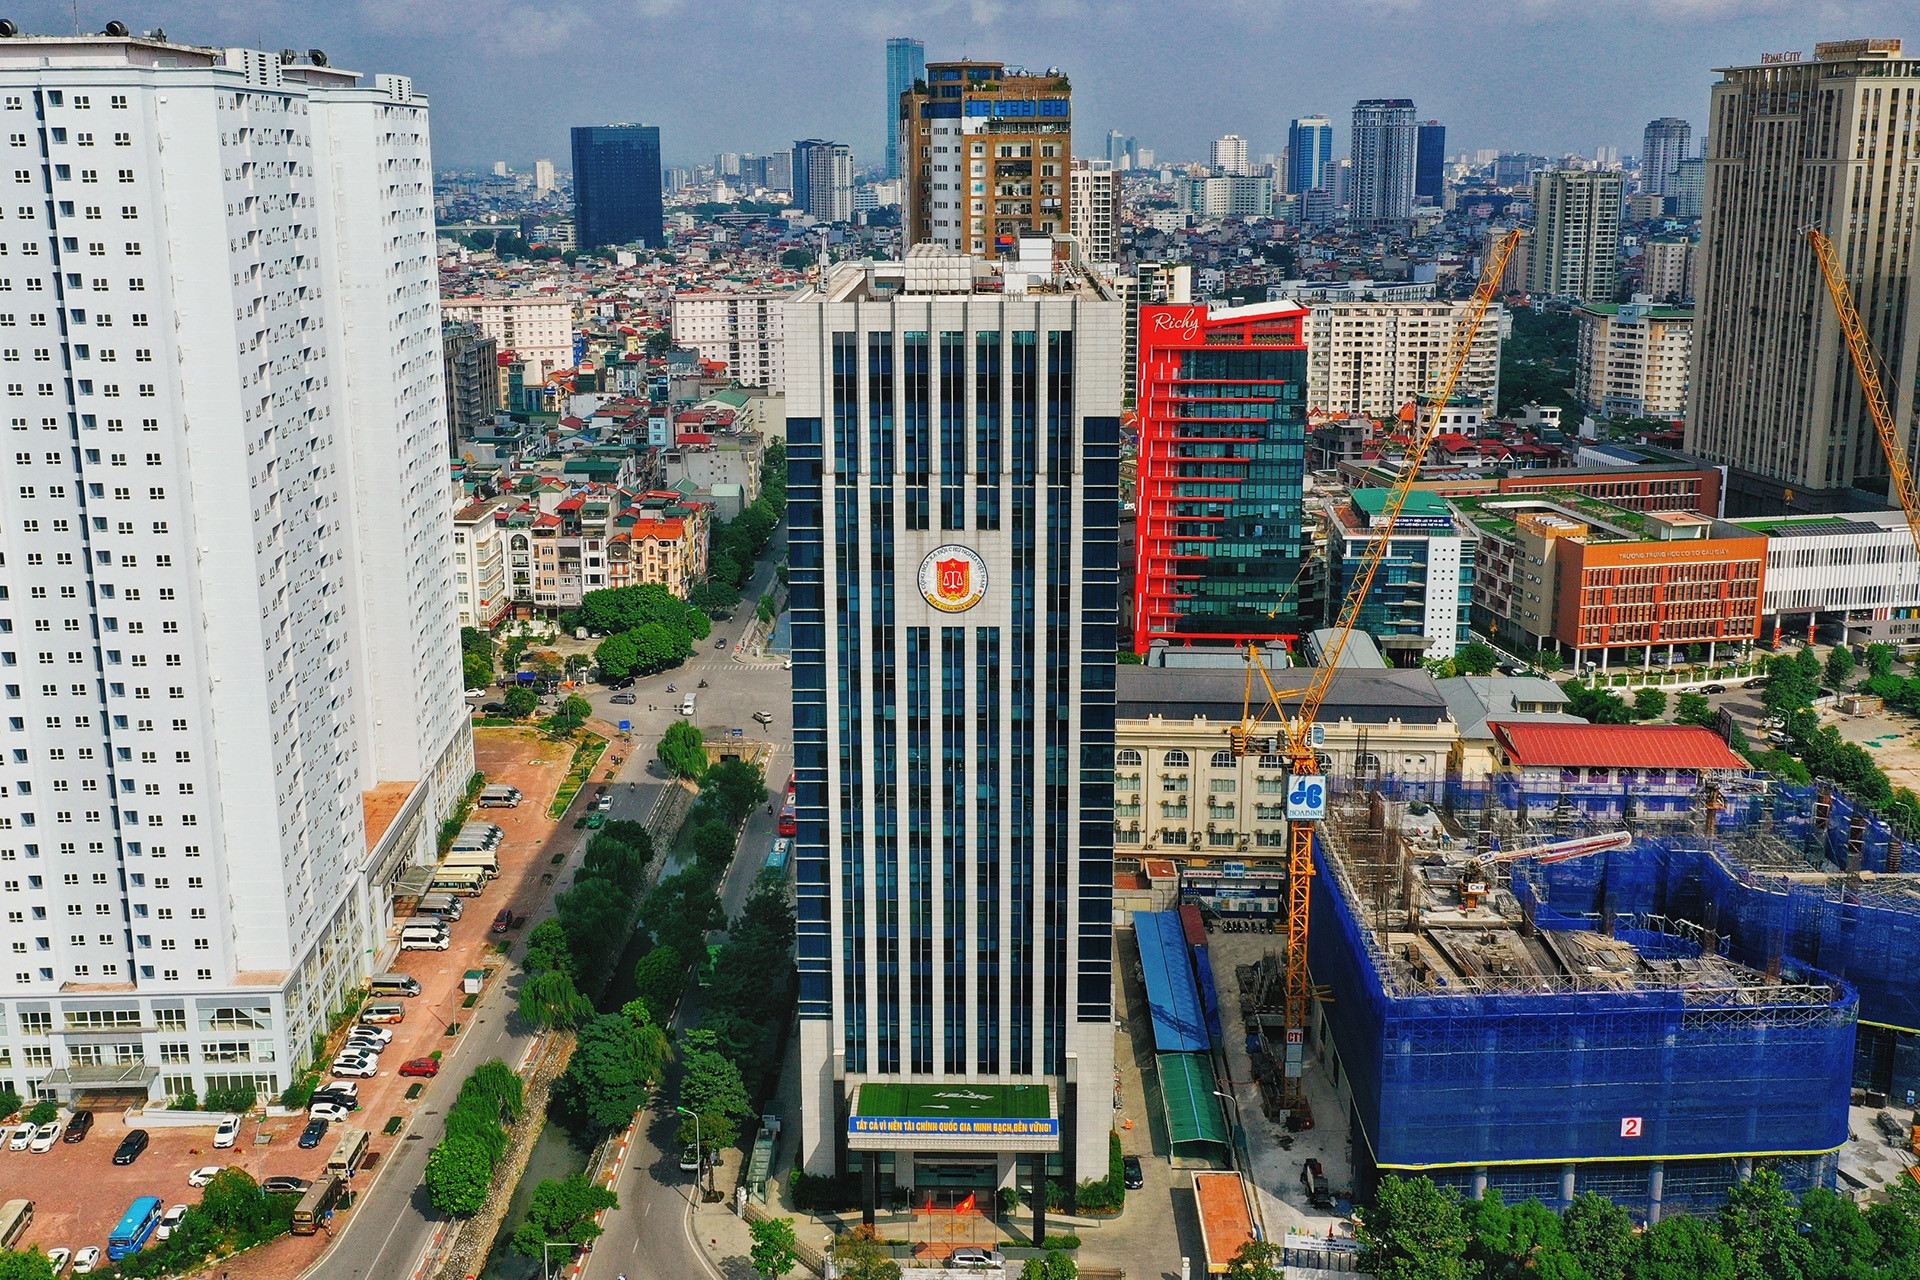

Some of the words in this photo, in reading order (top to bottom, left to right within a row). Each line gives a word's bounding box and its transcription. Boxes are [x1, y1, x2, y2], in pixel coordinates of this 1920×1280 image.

[1762, 53, 1783, 63] HOME
[1784, 51, 1802, 61] CITY
[1151, 308, 1199, 340] Richy
[1288, 1032, 1302, 1042] CT1
[856, 1118, 867, 1130] TẤT
[869, 1118, 878, 1130] CẢ
[879, 1120, 886, 1130] VÌ
[888, 1118, 902, 1131] NỀN
[904, 1120, 914, 1131] TÀI
[916, 1121, 938, 1131] CHÍNH
[939, 1118, 958, 1132] QUỐC
[960, 1123, 971, 1132] GIA
[973, 1123, 991, 1132] MINH
[1029, 1121, 1051, 1132] VỮNG!
[1625, 1119, 1637, 1135] 2
